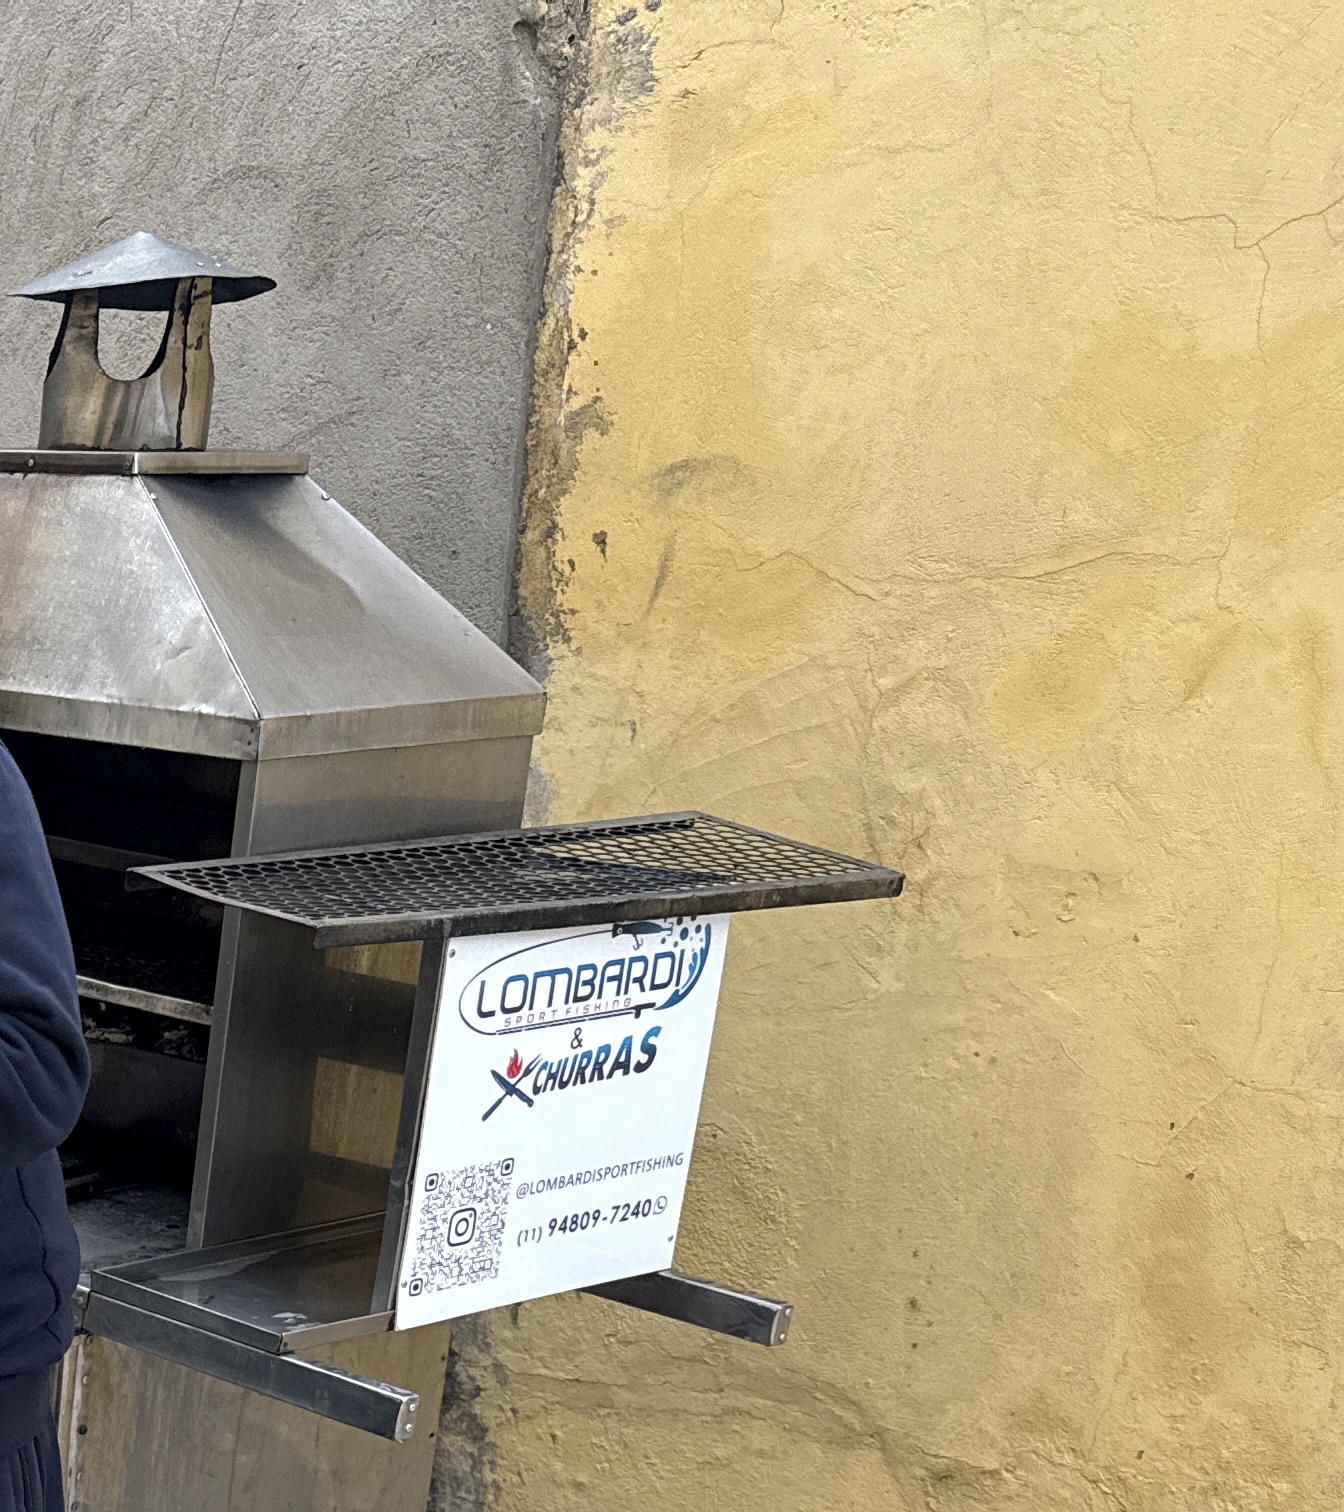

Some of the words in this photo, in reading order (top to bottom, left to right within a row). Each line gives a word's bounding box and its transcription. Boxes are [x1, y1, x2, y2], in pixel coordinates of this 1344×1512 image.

[476, 949, 686, 1019] LOMBARDI
[504, 1009, 559, 1027] SPORT
[565, 998, 633, 1015] FISHING
[531, 1026, 662, 1096] CHURRAS
[570, 1027, 583, 1049] &
[515, 1152, 685, 1200] @LOMBARDISPORTFISHING
[516, 1226, 543, 1248] (11)
[548, 1198, 653, 1238] 94809-7240
